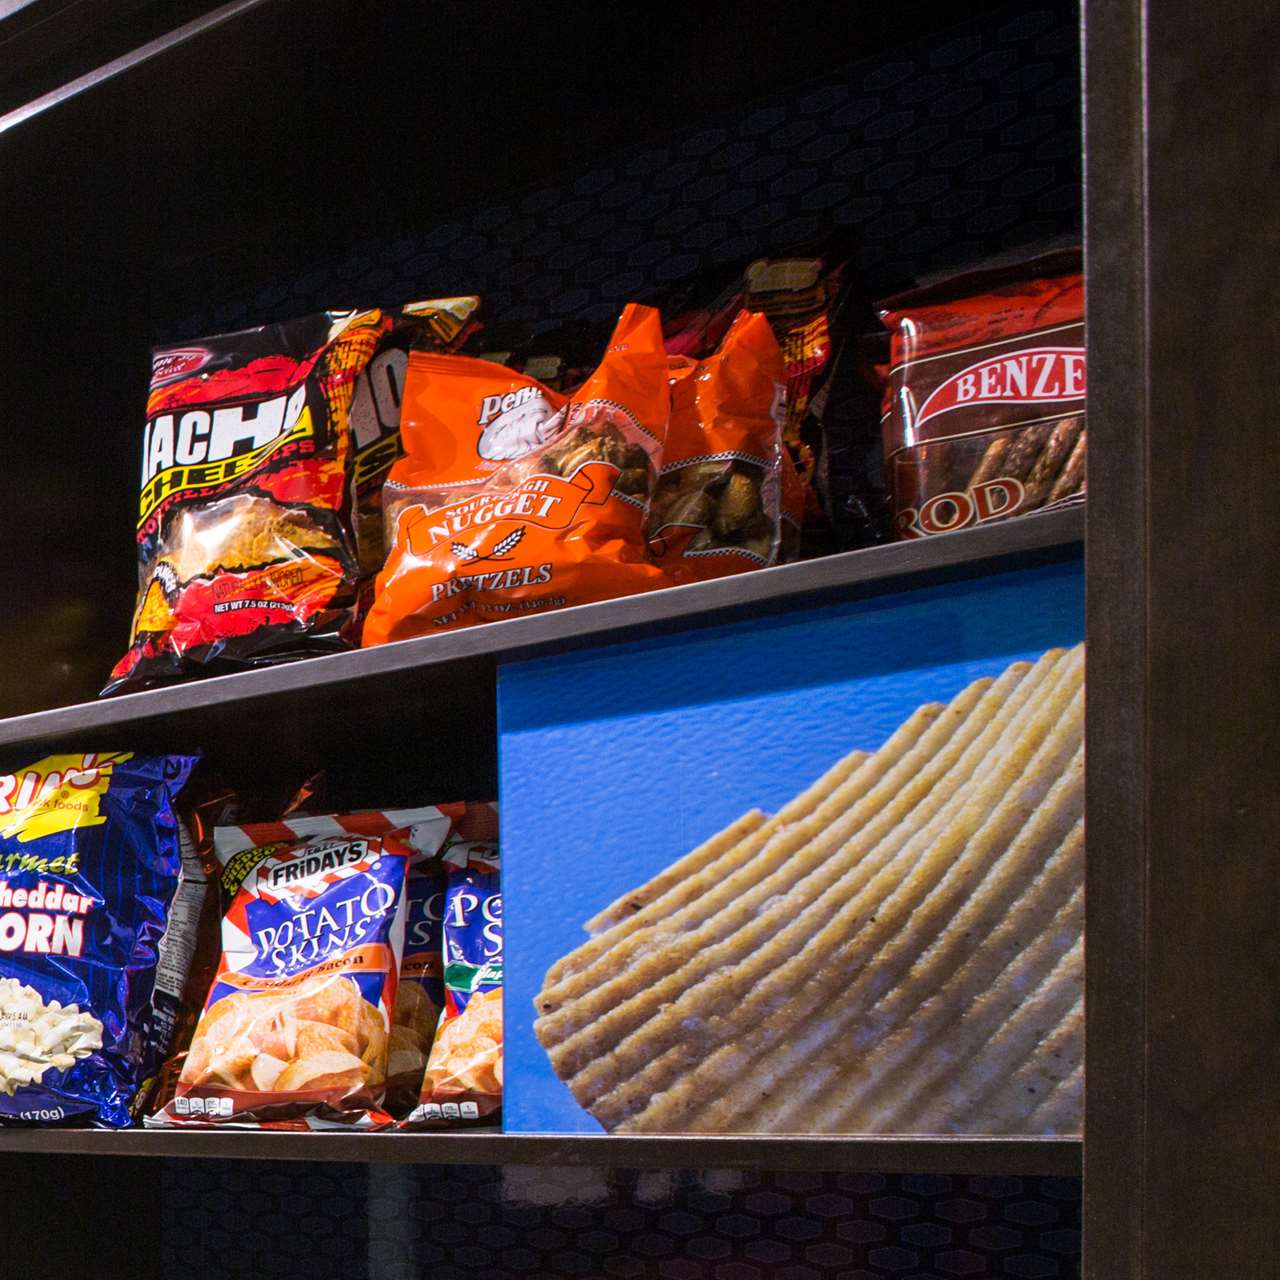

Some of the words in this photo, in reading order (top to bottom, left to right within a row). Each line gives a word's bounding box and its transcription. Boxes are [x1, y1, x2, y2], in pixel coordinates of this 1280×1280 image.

[428, 493, 561, 544] NUGGET
[431, 563, 553, 603] PRETZELS
[214, 603, 230, 614] NET
[231, 601, 243, 611] WT
[255, 882, 397, 959] POTATO
[266, 916, 373, 976] SKINS
[19, 1106, 65, 1122] (170g)
